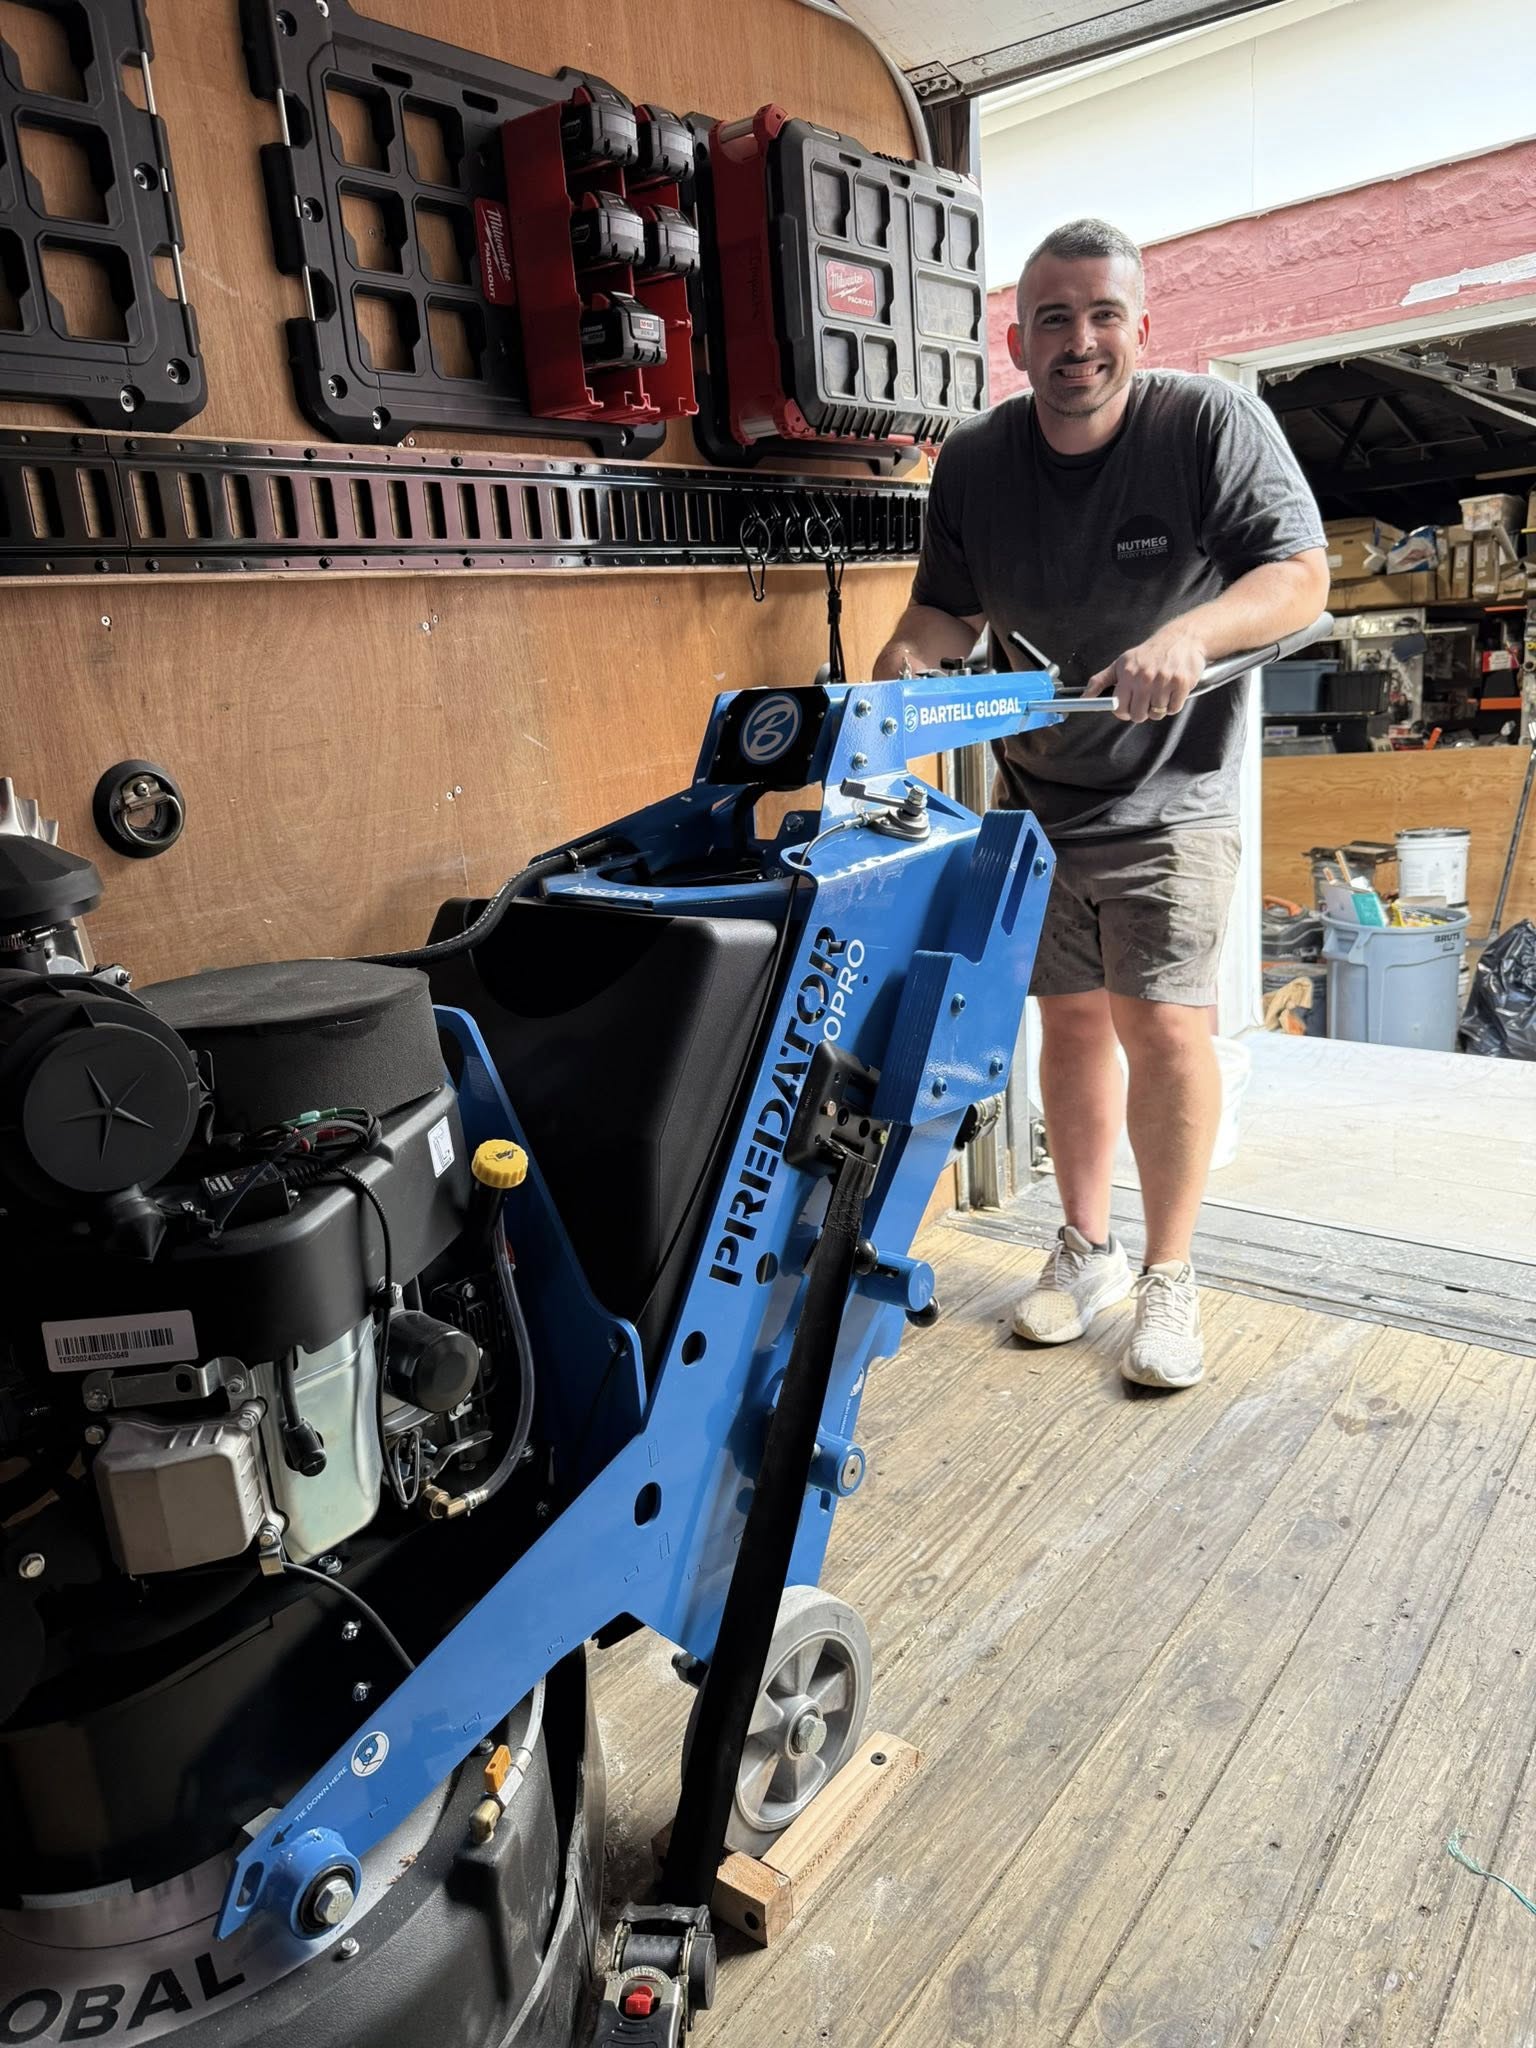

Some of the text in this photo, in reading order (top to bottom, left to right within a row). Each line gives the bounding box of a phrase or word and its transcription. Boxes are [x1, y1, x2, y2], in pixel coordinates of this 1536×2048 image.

[484, 242, 496, 299] PACKOUT
[486, 206, 511, 282] Milwaukee
[847, 295, 874, 307] PACKOUT
[1117, 536, 1168, 552] NUTMEG
[920, 702, 974, 725] BARTELL
[975, 697, 1021, 719] GLOBAL
[709, 926, 848, 1287] PREDATOR
[294, 1765, 349, 1822] TIE DOWN HERE
